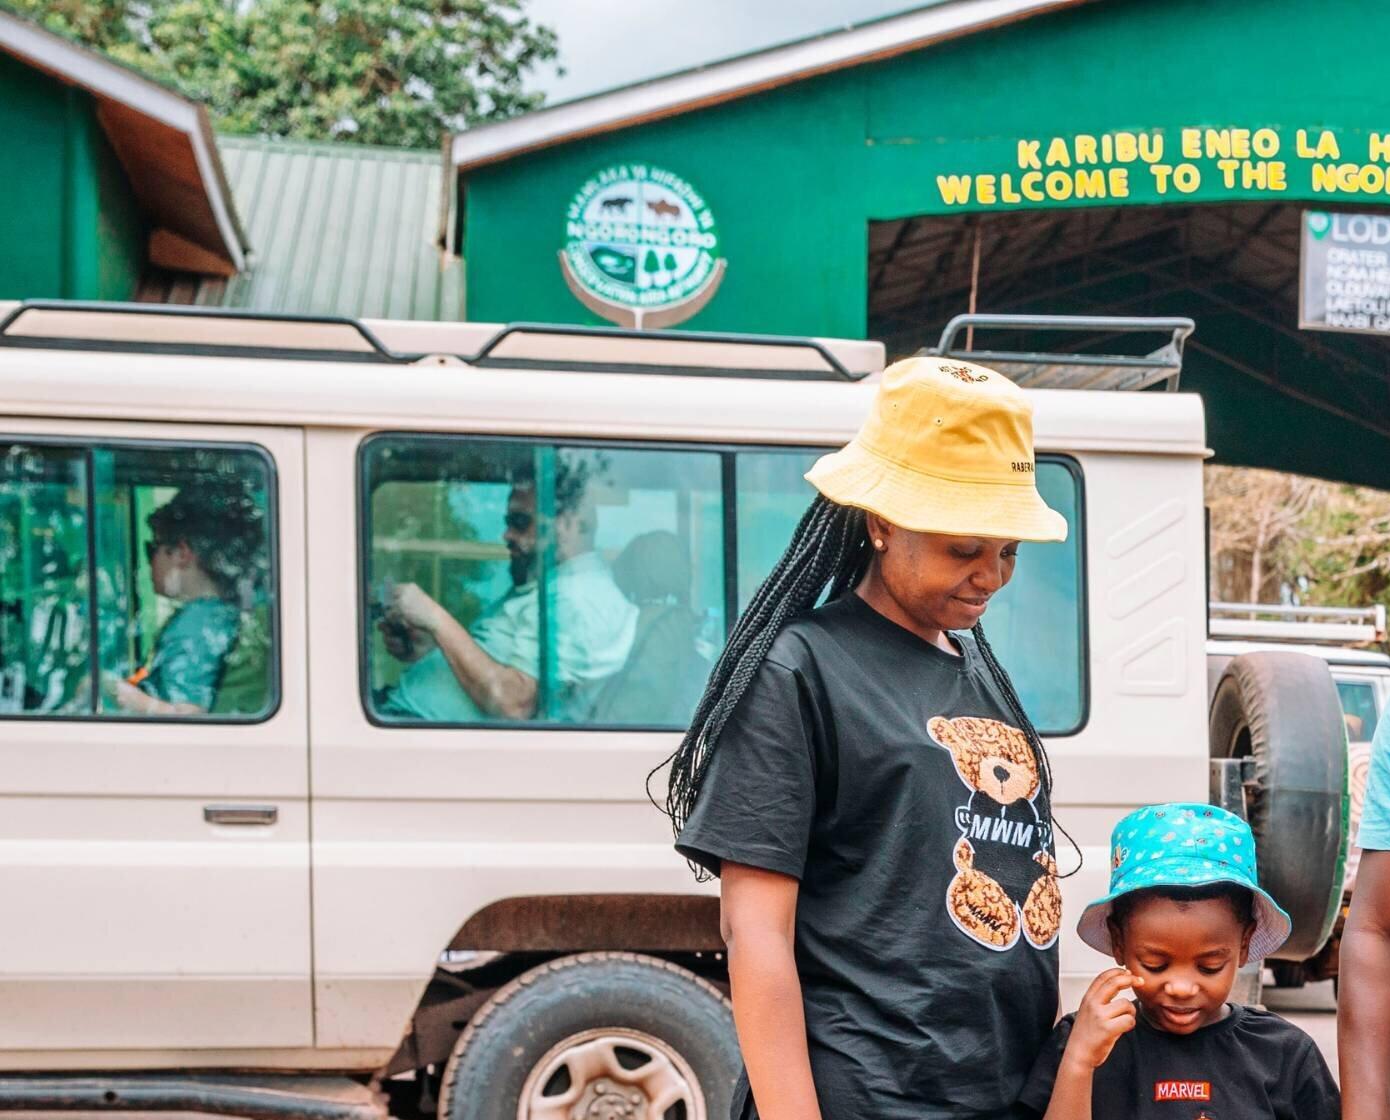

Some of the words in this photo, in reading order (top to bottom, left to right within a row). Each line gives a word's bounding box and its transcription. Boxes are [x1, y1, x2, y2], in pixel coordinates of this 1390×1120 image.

[1017, 131, 1165, 170] KARIBU
[1182, 129, 1280, 160] ENEO
[1295, 130, 1340, 159] LA
[937, 167, 1129, 205] WELCOME
[1150, 163, 1202, 194] TO
[1217, 159, 1288, 192] THE
[1158, 1082, 1209, 1098] MARVEL
